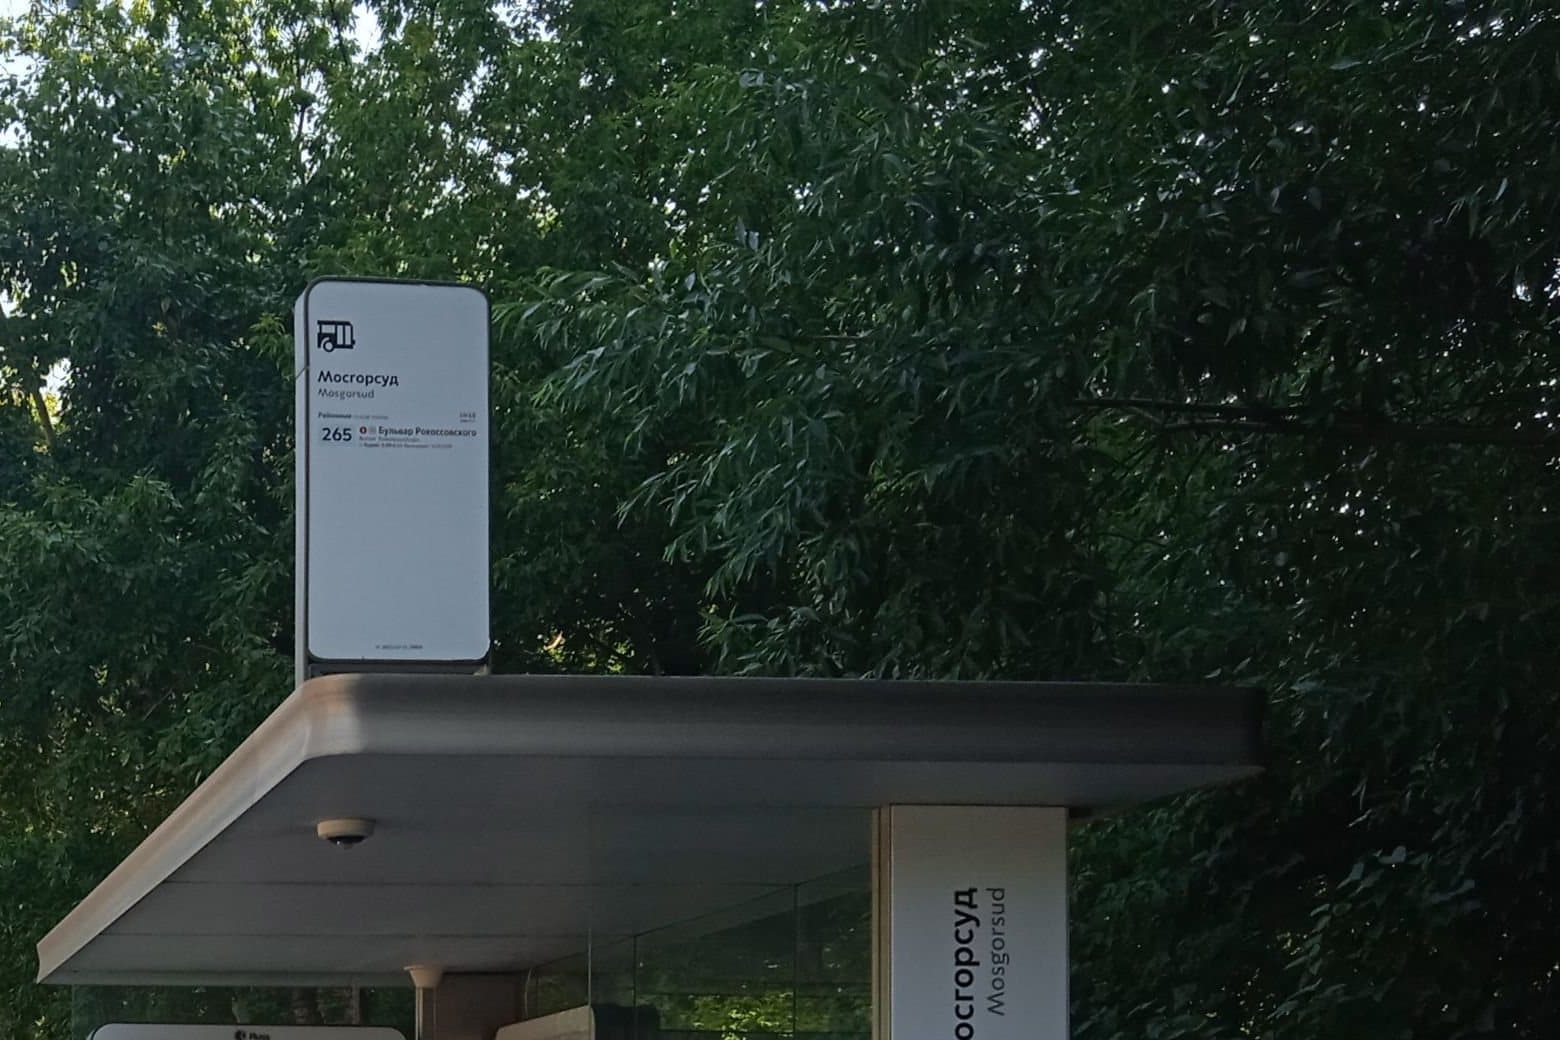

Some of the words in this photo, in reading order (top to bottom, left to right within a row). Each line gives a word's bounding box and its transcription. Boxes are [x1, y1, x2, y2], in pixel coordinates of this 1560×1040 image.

[318, 370, 400, 386] Мосгорсуд
[318, 388, 375, 400] Mosgorsud
[322, 427, 352, 442] 265
[378, 425, 414, 437] Бульвар
[415, 426, 477, 437] Рокоссовского
[986, 887, 1009, 1016] Mosgorsud
